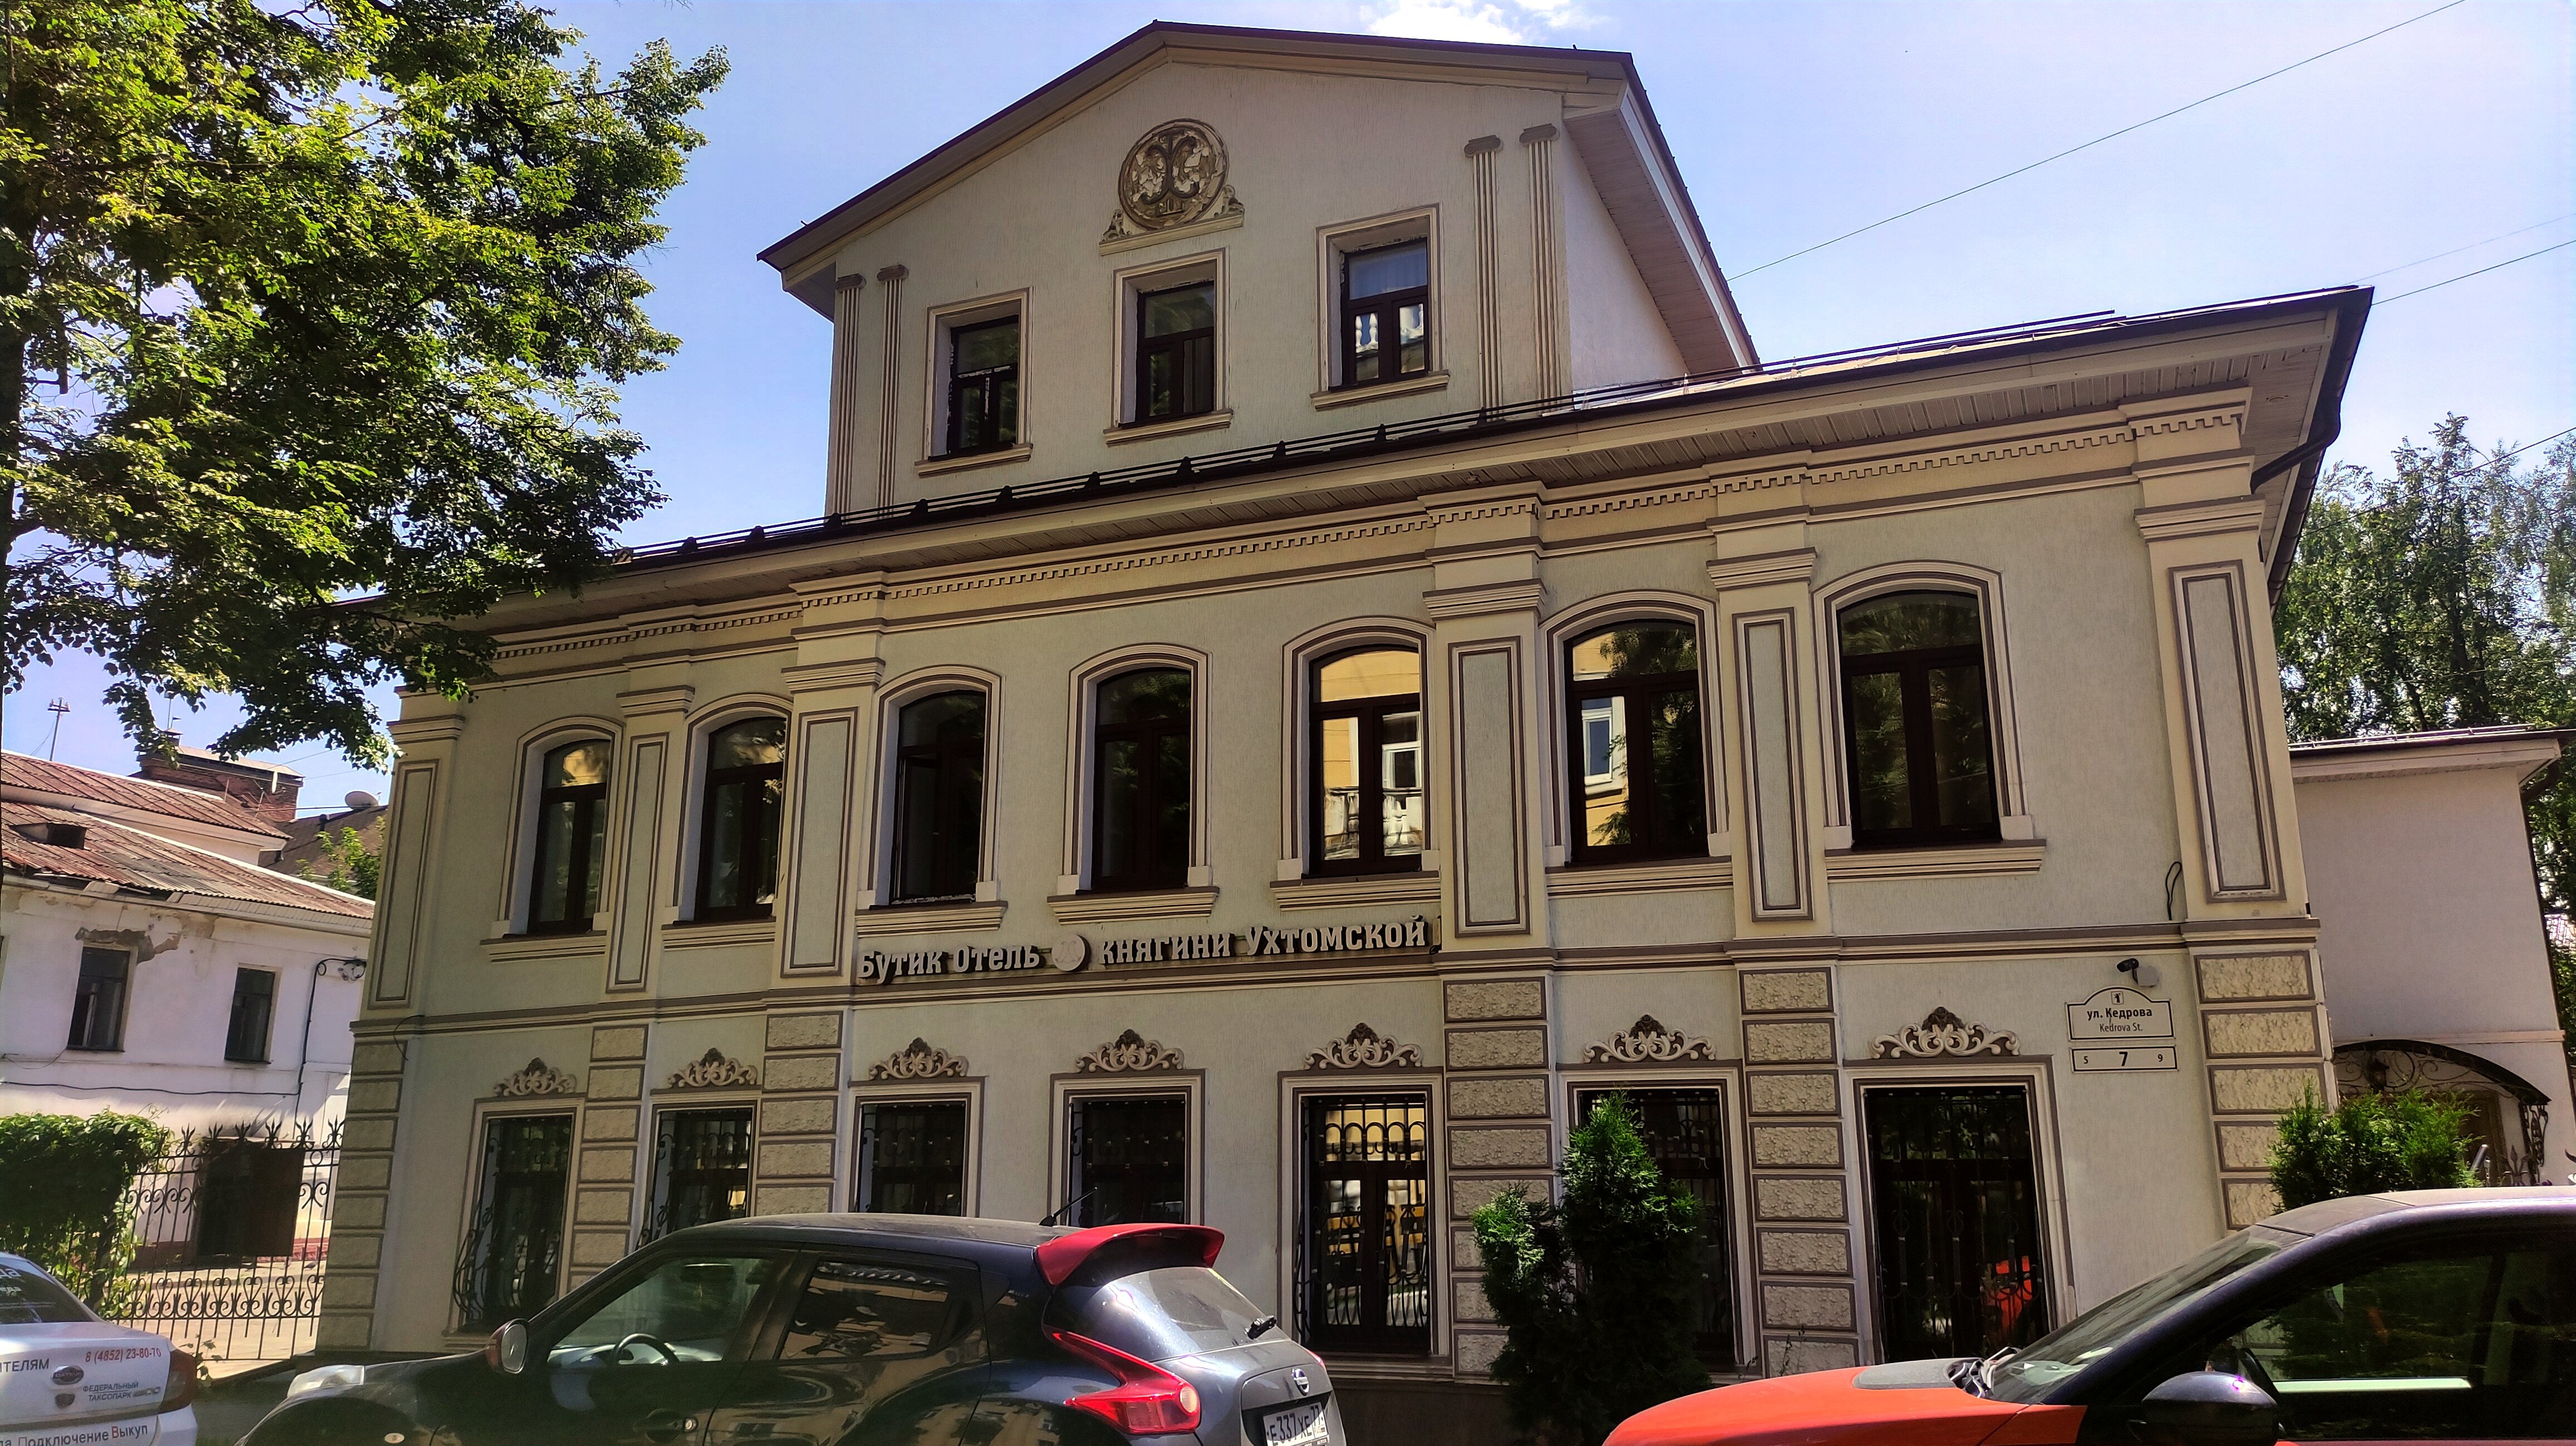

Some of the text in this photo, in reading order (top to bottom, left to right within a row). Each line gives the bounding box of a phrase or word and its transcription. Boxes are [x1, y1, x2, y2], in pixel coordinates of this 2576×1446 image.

[858, 914, 1426, 985] Бутик Отель княгини Ухтомской
[2087, 1007, 2153, 1021] ул. Кедрова
[2099, 1022, 2143, 1032] Kedrova St.
[2083, 1056, 2089, 1064] 5
[2119, 1051, 2128, 1067] 7
[2157, 1053, 2163, 1063] 9
[85, 1347, 162, 1365] 8 (4852) 23-80-70
[0, 1359, 50, 1372] ТЕЛЯМ
[82, 1380, 139, 1392] ФЕДЕРАЛЬНЫЙ
[88, 1392, 131, 1401] ТАКСОПАРК
[18, 1430, 109, 1446] Подключение
[111, 1425, 148, 1439] Выкуп
